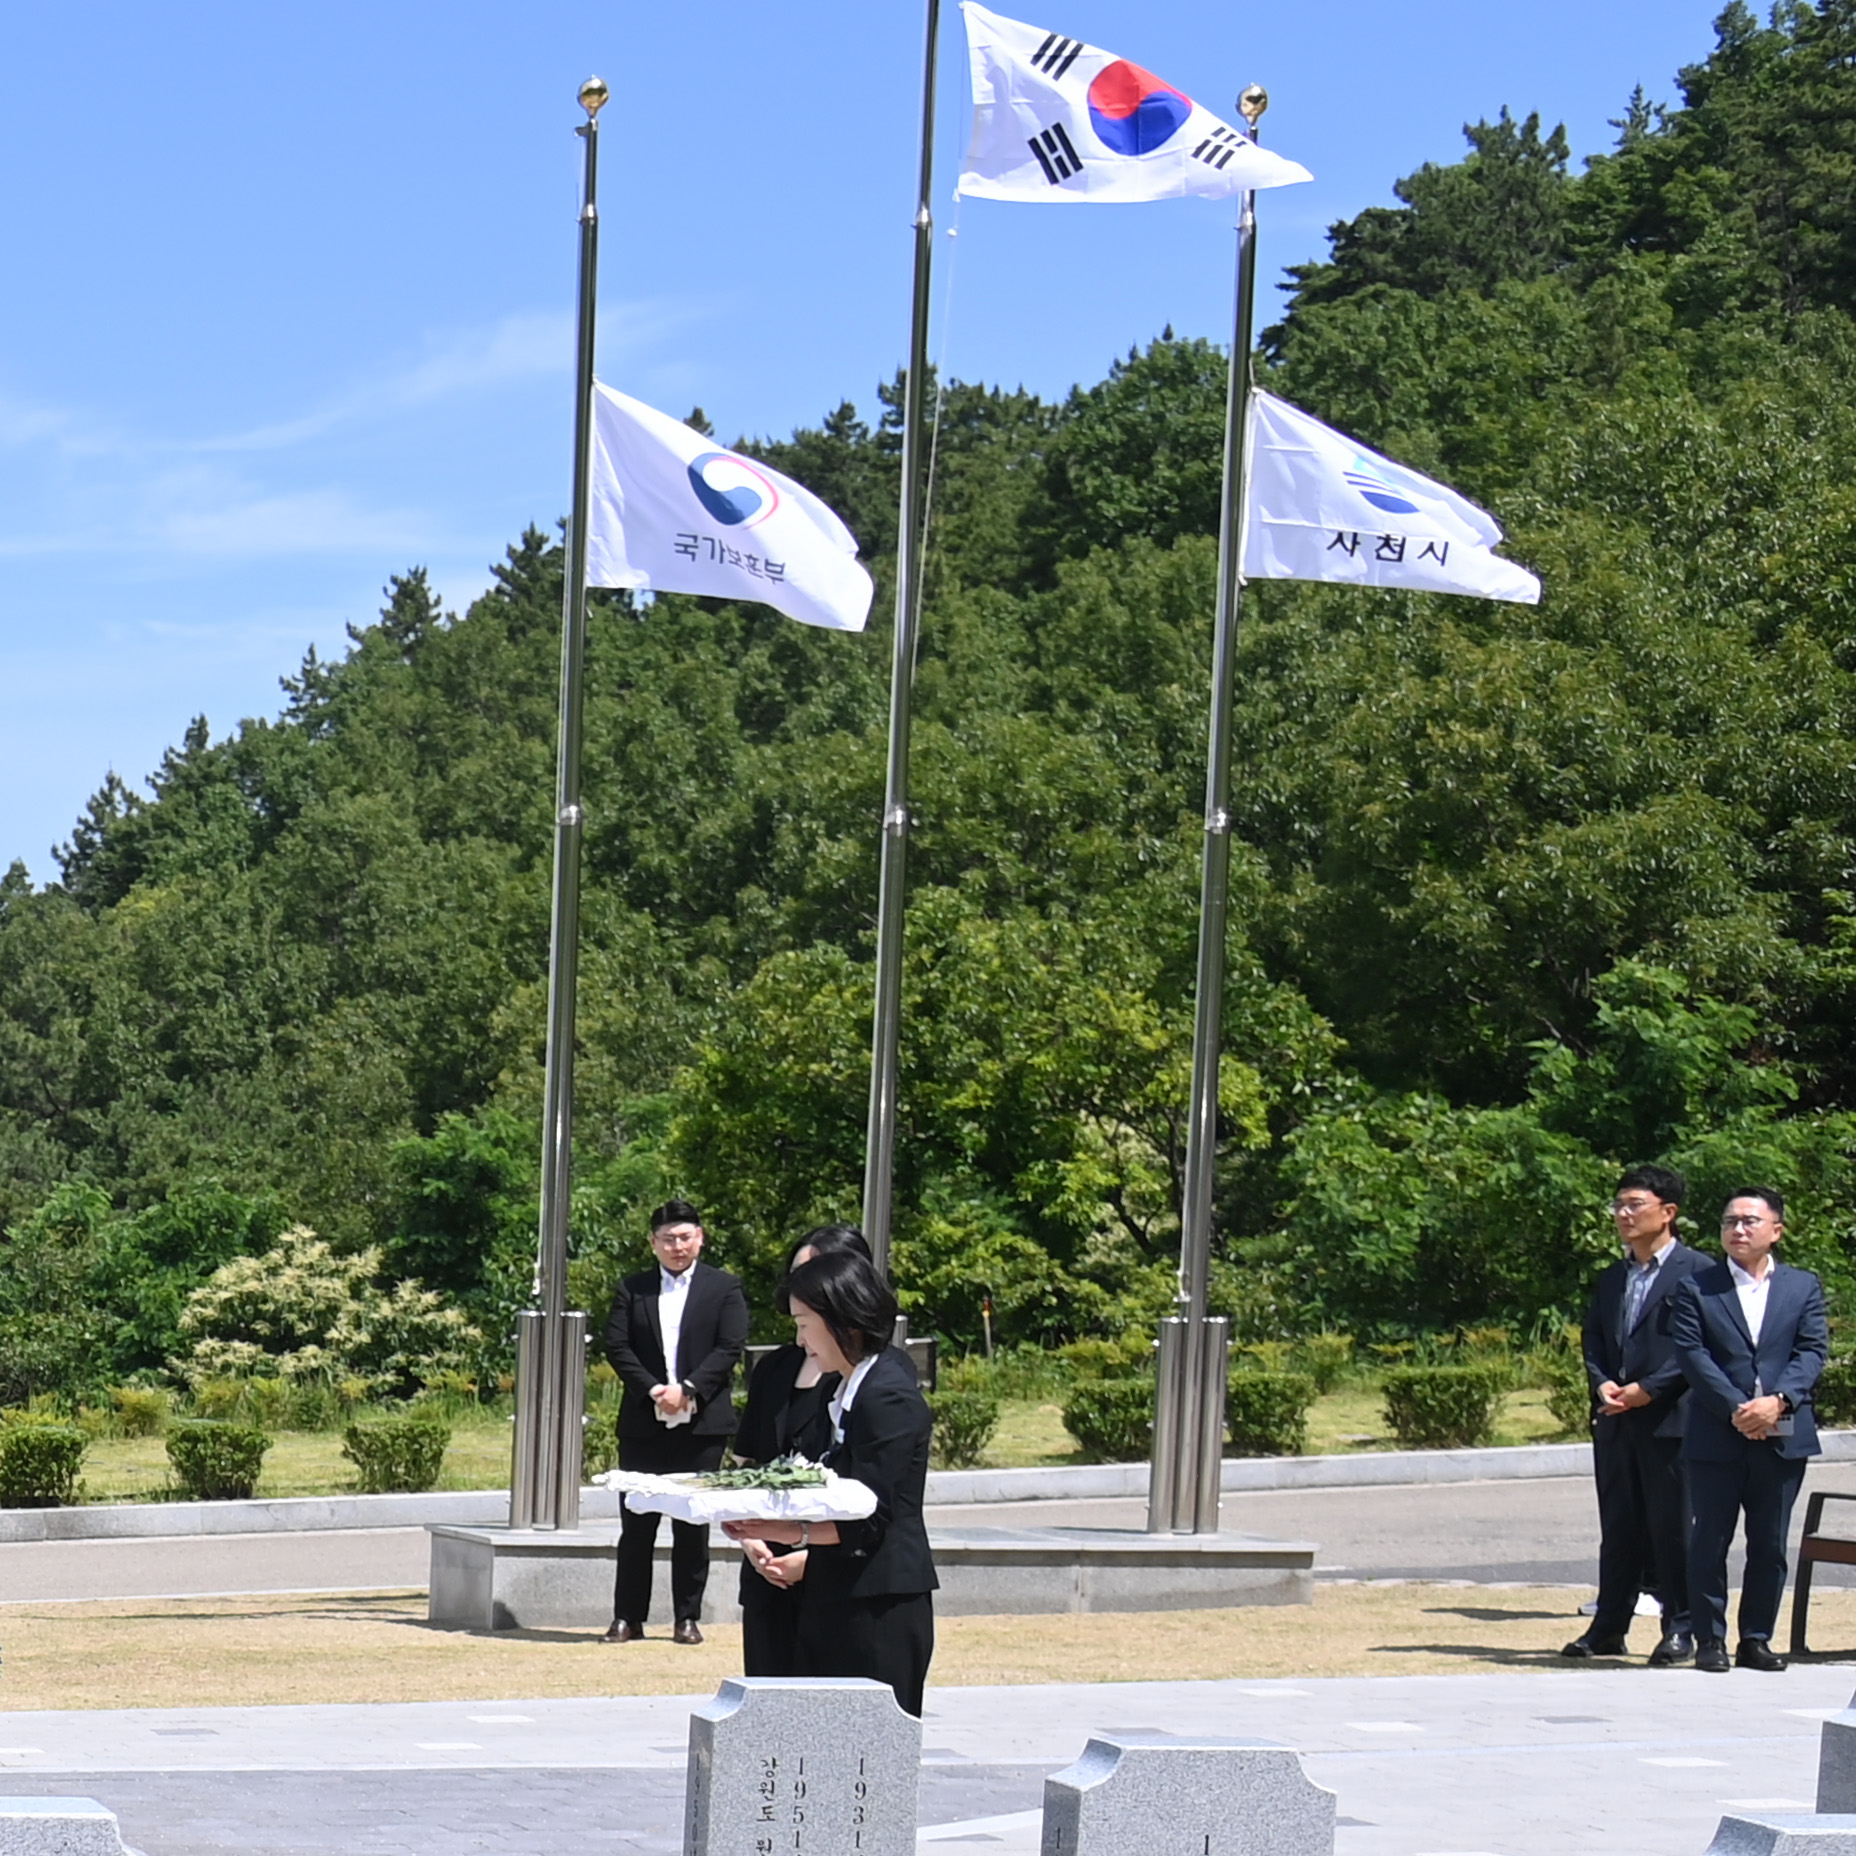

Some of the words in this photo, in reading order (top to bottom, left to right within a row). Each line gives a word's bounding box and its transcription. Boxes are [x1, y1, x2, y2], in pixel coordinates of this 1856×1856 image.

[674, 533, 786, 585] 국가보훈부
[1326, 532, 1449, 567] 사천시
[757, 1758, 777, 1821] 강원도
